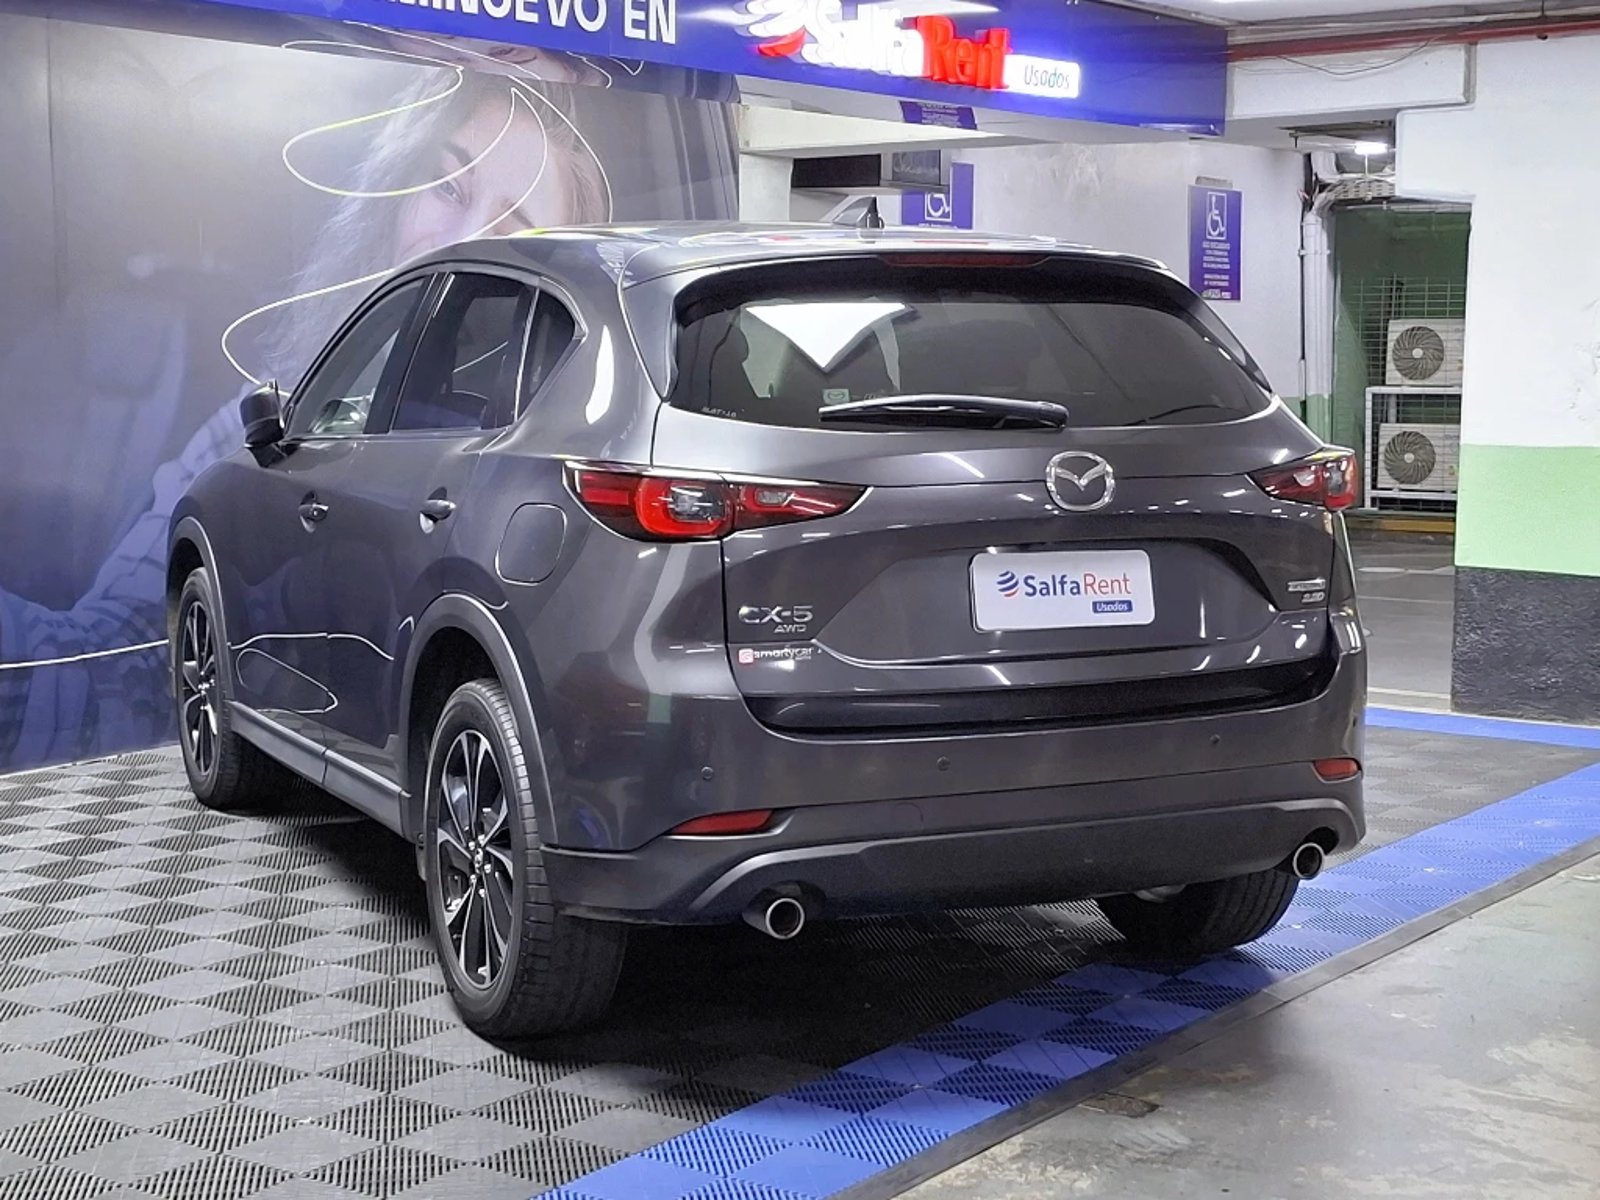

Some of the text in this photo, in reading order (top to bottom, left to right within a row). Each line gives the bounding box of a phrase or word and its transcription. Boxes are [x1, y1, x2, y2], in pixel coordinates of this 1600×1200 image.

[624, 0, 676, 44] EN
[1024, 64, 1070, 90] Usados
[1023, 572, 1132, 597] SalfaRent
[738, 605, 814, 624] CX-5
[1096, 602, 1129, 612] Usados
[773, 624, 807, 633] AWD
